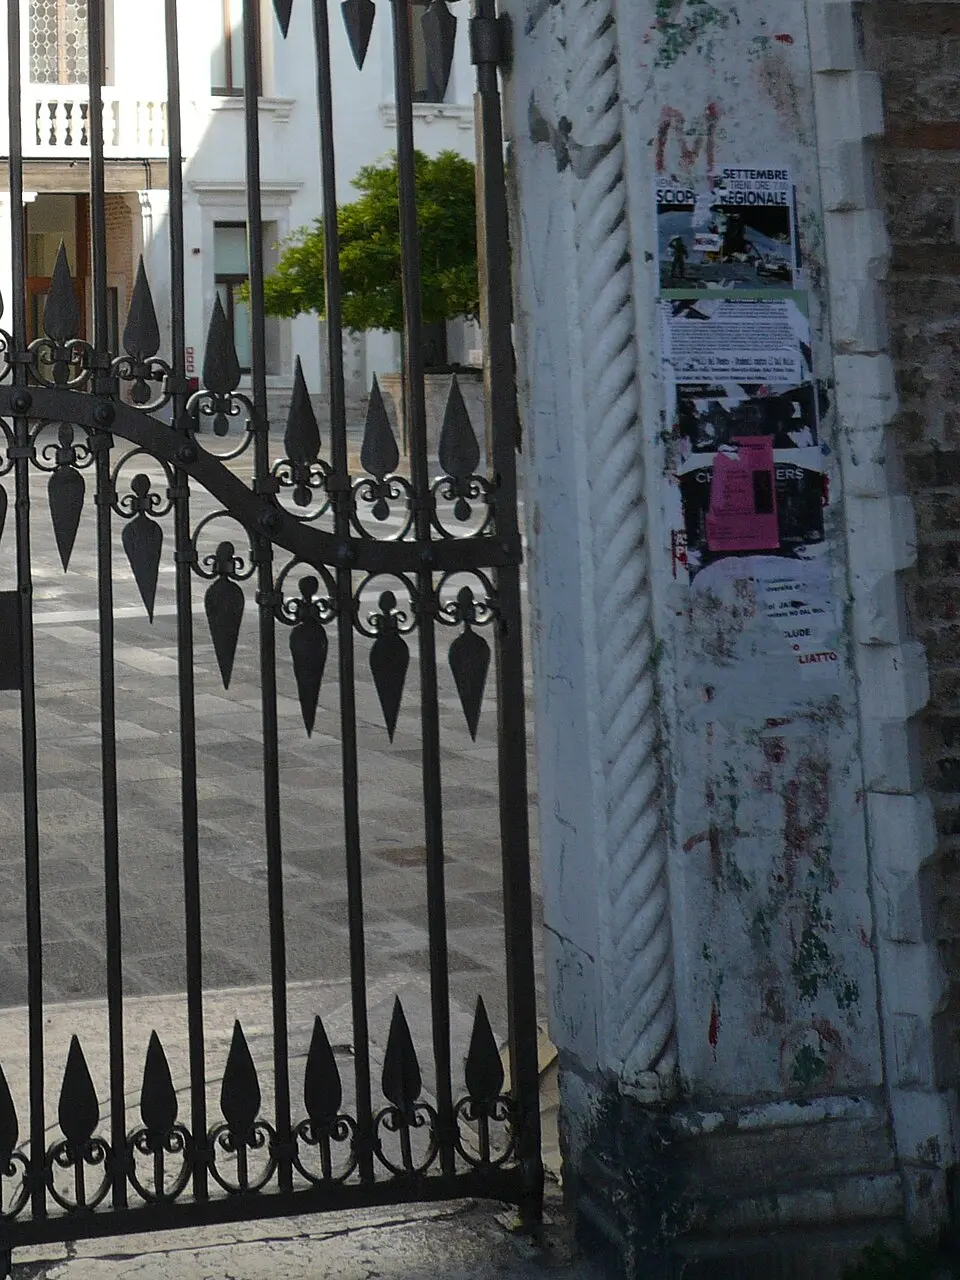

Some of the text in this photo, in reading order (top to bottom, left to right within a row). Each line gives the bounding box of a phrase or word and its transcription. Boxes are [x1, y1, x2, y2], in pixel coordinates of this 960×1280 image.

[723, 169, 788, 180] SETTEMBRE
[776, 468, 804, 480] ERS
[797, 651, 838, 664] LIATTO
